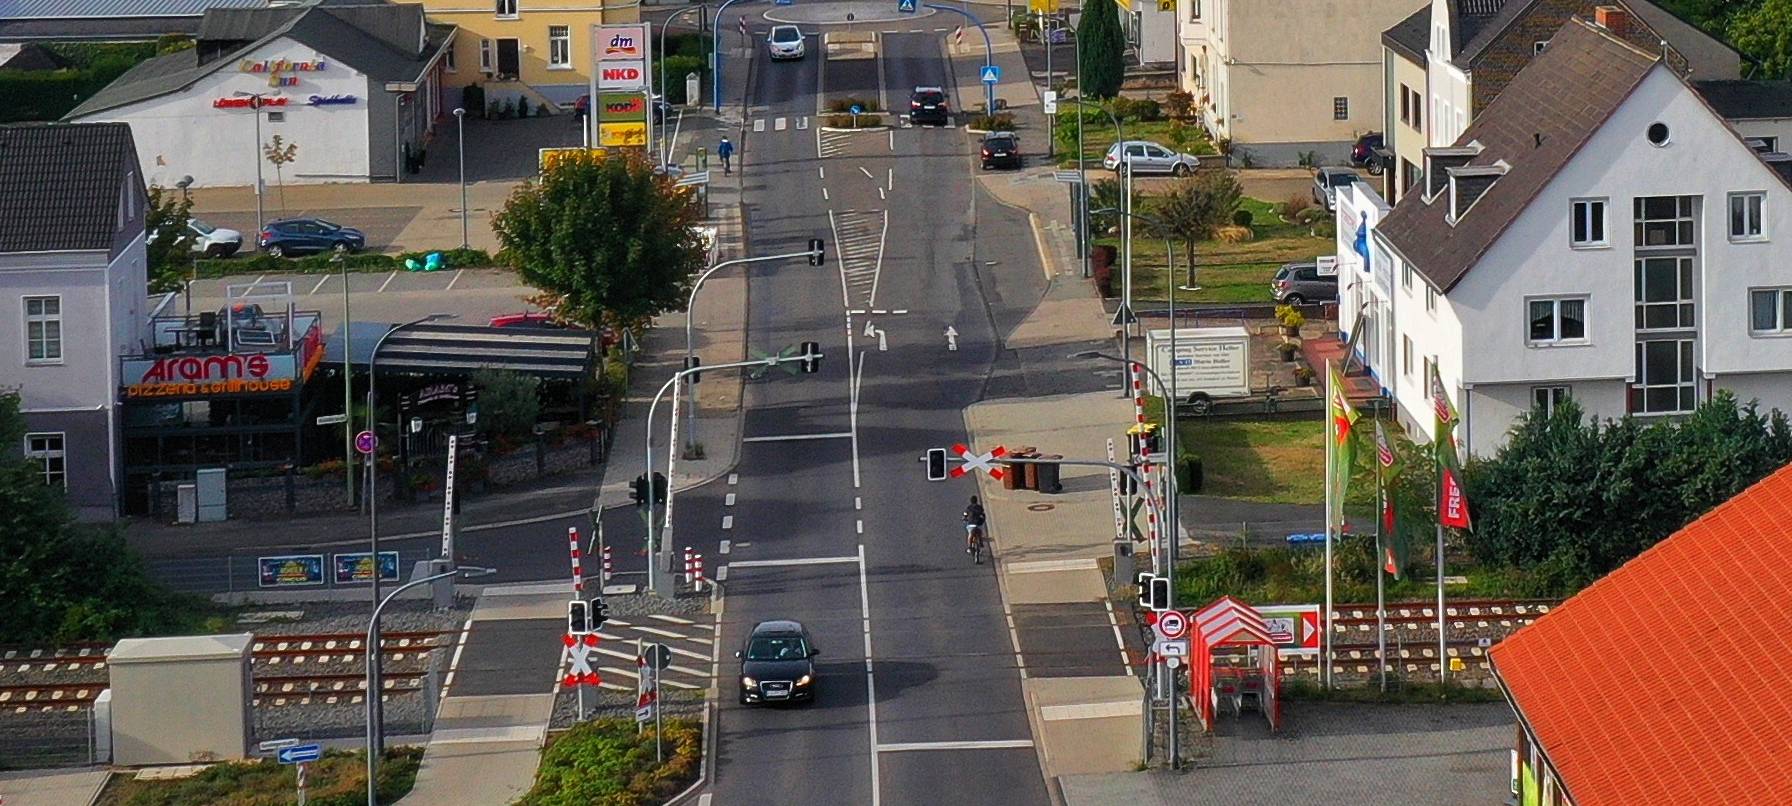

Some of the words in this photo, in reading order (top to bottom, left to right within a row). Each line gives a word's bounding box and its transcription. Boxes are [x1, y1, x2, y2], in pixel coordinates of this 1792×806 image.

[611, 34, 633, 47] dm
[239, 57, 326, 75] California
[602, 69, 639, 80] NKD
[141, 354, 269, 384] Aram's
